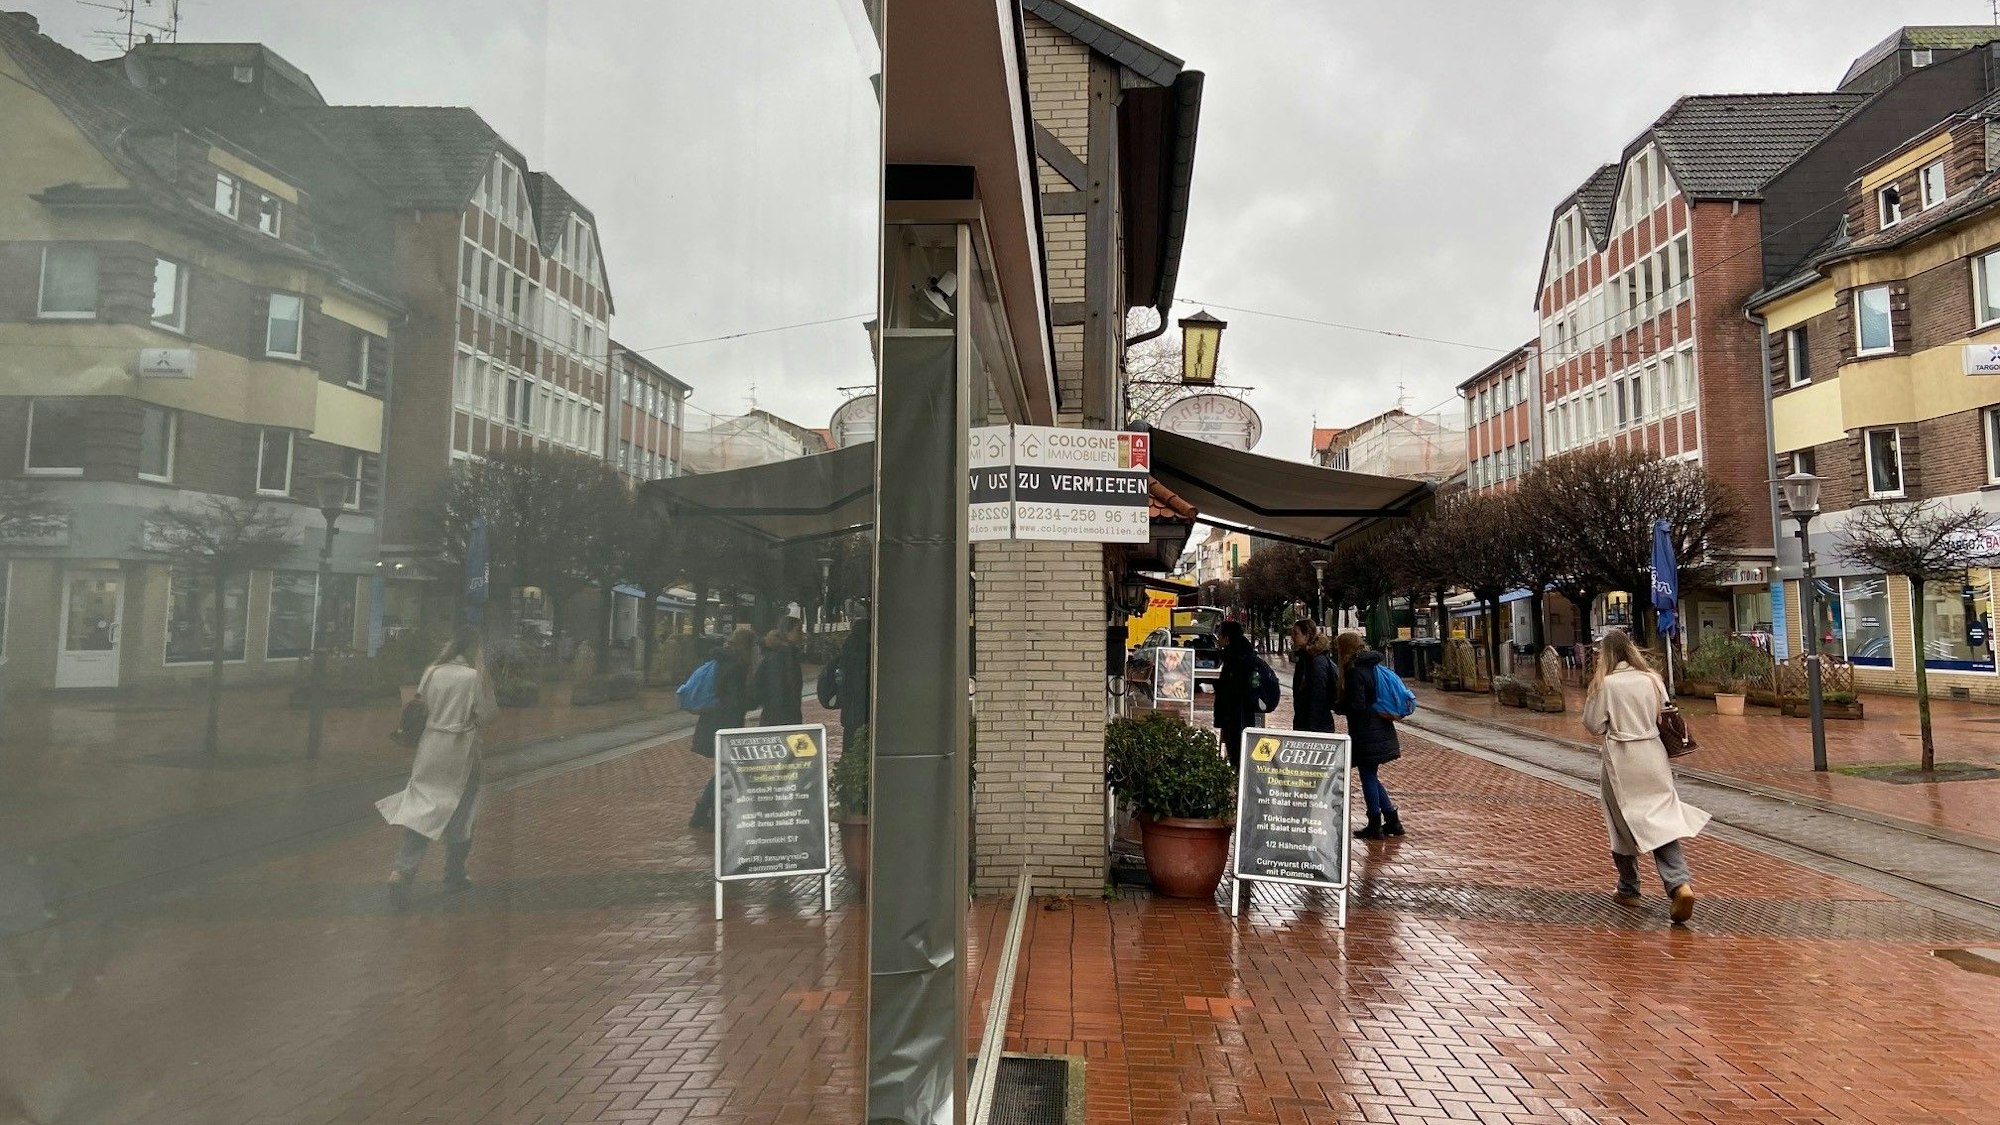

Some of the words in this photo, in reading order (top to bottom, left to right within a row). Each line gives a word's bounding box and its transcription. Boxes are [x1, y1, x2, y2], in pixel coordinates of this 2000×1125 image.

[1048, 435, 1116, 450] COLOGNE
[1048, 449, 1116, 462] IMMOBILIEN
[1018, 472, 1040, 489] ZU
[1051, 474, 1148, 494] VERMIETEN
[1018, 507, 1096, 522] 02234-250
[1105, 510, 1122, 523] 96
[1131, 511, 1148, 524] 15
[1020, 524, 1147, 536] www.cologneimmobilien.de
[1986, 536, 2000, 548] BA
[1286, 741, 1336, 751] FRECHENER
[1280, 748, 1336, 766] GRILL
[1269, 789, 1292, 798] Döner
[1272, 798, 1291, 806] Salat
[1264, 814, 1300, 824] Türkische
[1302, 818, 1322, 826] Pizza
[1270, 824, 1290, 832] Salat
[1308, 826, 1328, 835] Soße
[1278, 842, 1317, 852] Hähnchen
[1256, 858, 1300, 868] Currywurst
[1301, 862, 1324, 872] (Rind)
[1266, 868, 1278, 876] mit
[1280, 869, 1314, 878] Pommes
